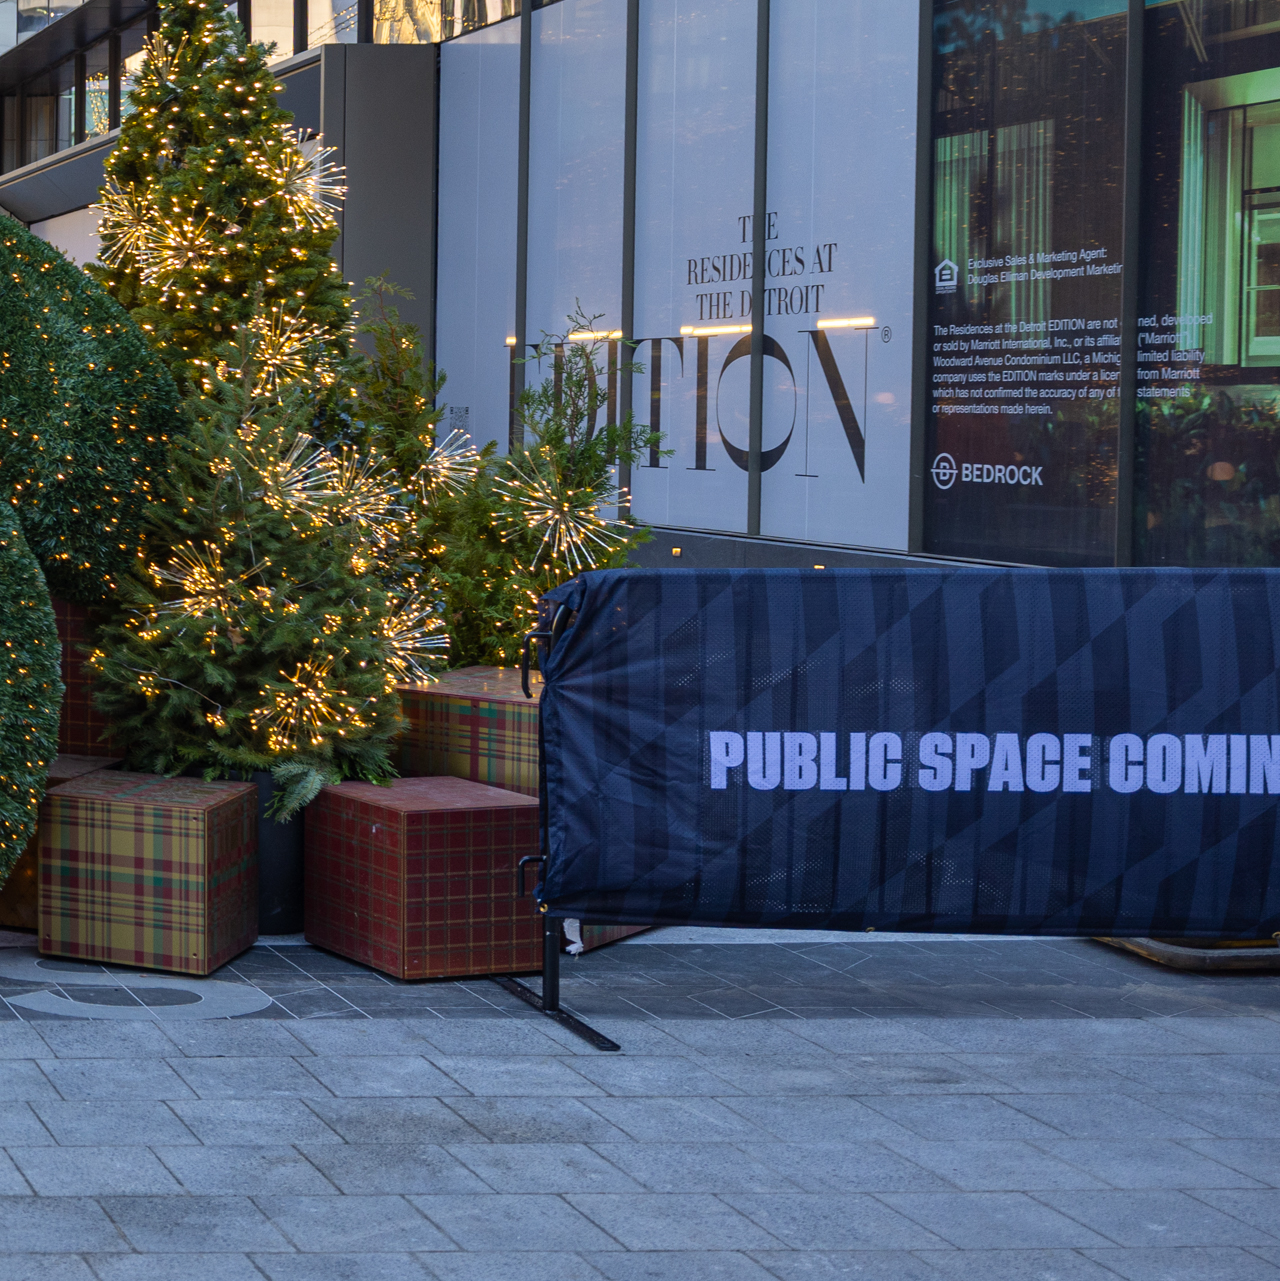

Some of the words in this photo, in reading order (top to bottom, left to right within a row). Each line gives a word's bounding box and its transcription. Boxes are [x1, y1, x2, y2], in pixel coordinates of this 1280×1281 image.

[738, 212, 778, 244] TE
[687, 246, 805, 285] RESIDECES
[809, 243, 838, 274] AT
[968, 257, 1004, 269] Exclusive
[1005, 254, 1027, 267] Sales
[1029, 254, 1035, 264] &
[1036, 250, 1077, 264] Marketing
[1079, 247, 1107, 261] Agent:
[967, 272, 999, 286] Douglas
[1000, 270, 1029, 282] Elliman
[1030, 266, 1085, 281] Development
[1086, 263, 1123, 276] Marketin
[696, 291, 733, 320] THE
[740, 284, 824, 318] DTROIT
[934, 325, 948, 336] The
[949, 324, 993, 336] Residences
[994, 324, 1003, 334] at
[1004, 323, 1017, 333] the
[1019, 321, 1046, 333] Detroit
[1048, 319, 1085, 331] EDITION
[1087, 321, 1101, 330] are
[1102, 318, 1118, 329] not
[1161, 312, 1213, 326] developed
[933, 342, 942, 352] or
[942, 340, 959, 351] sold
[960, 340, 970, 353] by
[971, 339, 1001, 351] Marriott
[1001, 337, 1052, 350] International,
[1073, 338, 1083, 347] or
[1084, 335, 1095, 347] its
[933, 355, 973, 367] Woodward
[974, 355, 1003, 366] Avenue
[1004, 353, 1061, 366] Condominium
[1092, 351, 1121, 366] Michig
[1137, 350, 1169, 362] limited
[1170, 349, 1205, 363] liability
[932, 373, 967, 385] company
[968, 373, 986, 382] uses
[988, 371, 1001, 382] the
[1002, 370, 1037, 382] EDITION
[1038, 371, 1064, 381] marks
[1065, 370, 1091, 381] under
[1137, 368, 1159, 380] from
[1161, 367, 1200, 380] Marriott
[932, 387, 954, 398] which
[955, 387, 970, 398] has
[970, 388, 983, 398] not
[984, 386, 1023, 398] confirmed
[1024, 387, 1038, 398] the
[1039, 388, 1076, 400] accuracy
[1077, 386, 1088, 397] of
[1088, 388, 1104, 400] any
[1106, 386, 1116, 397] of
[1136, 386, 1191, 398] statements
[932, 405, 941, 414] or
[941, 403, 999, 415] representations
[1000, 404, 1023, 414] made
[1025, 403, 1053, 415] herein.
[962, 463, 1044, 486] BEDROCK
[709, 731, 903, 792] PUBLIC
[918, 732, 1092, 793] SPACE
[1108, 733, 1280, 794] COMIN
